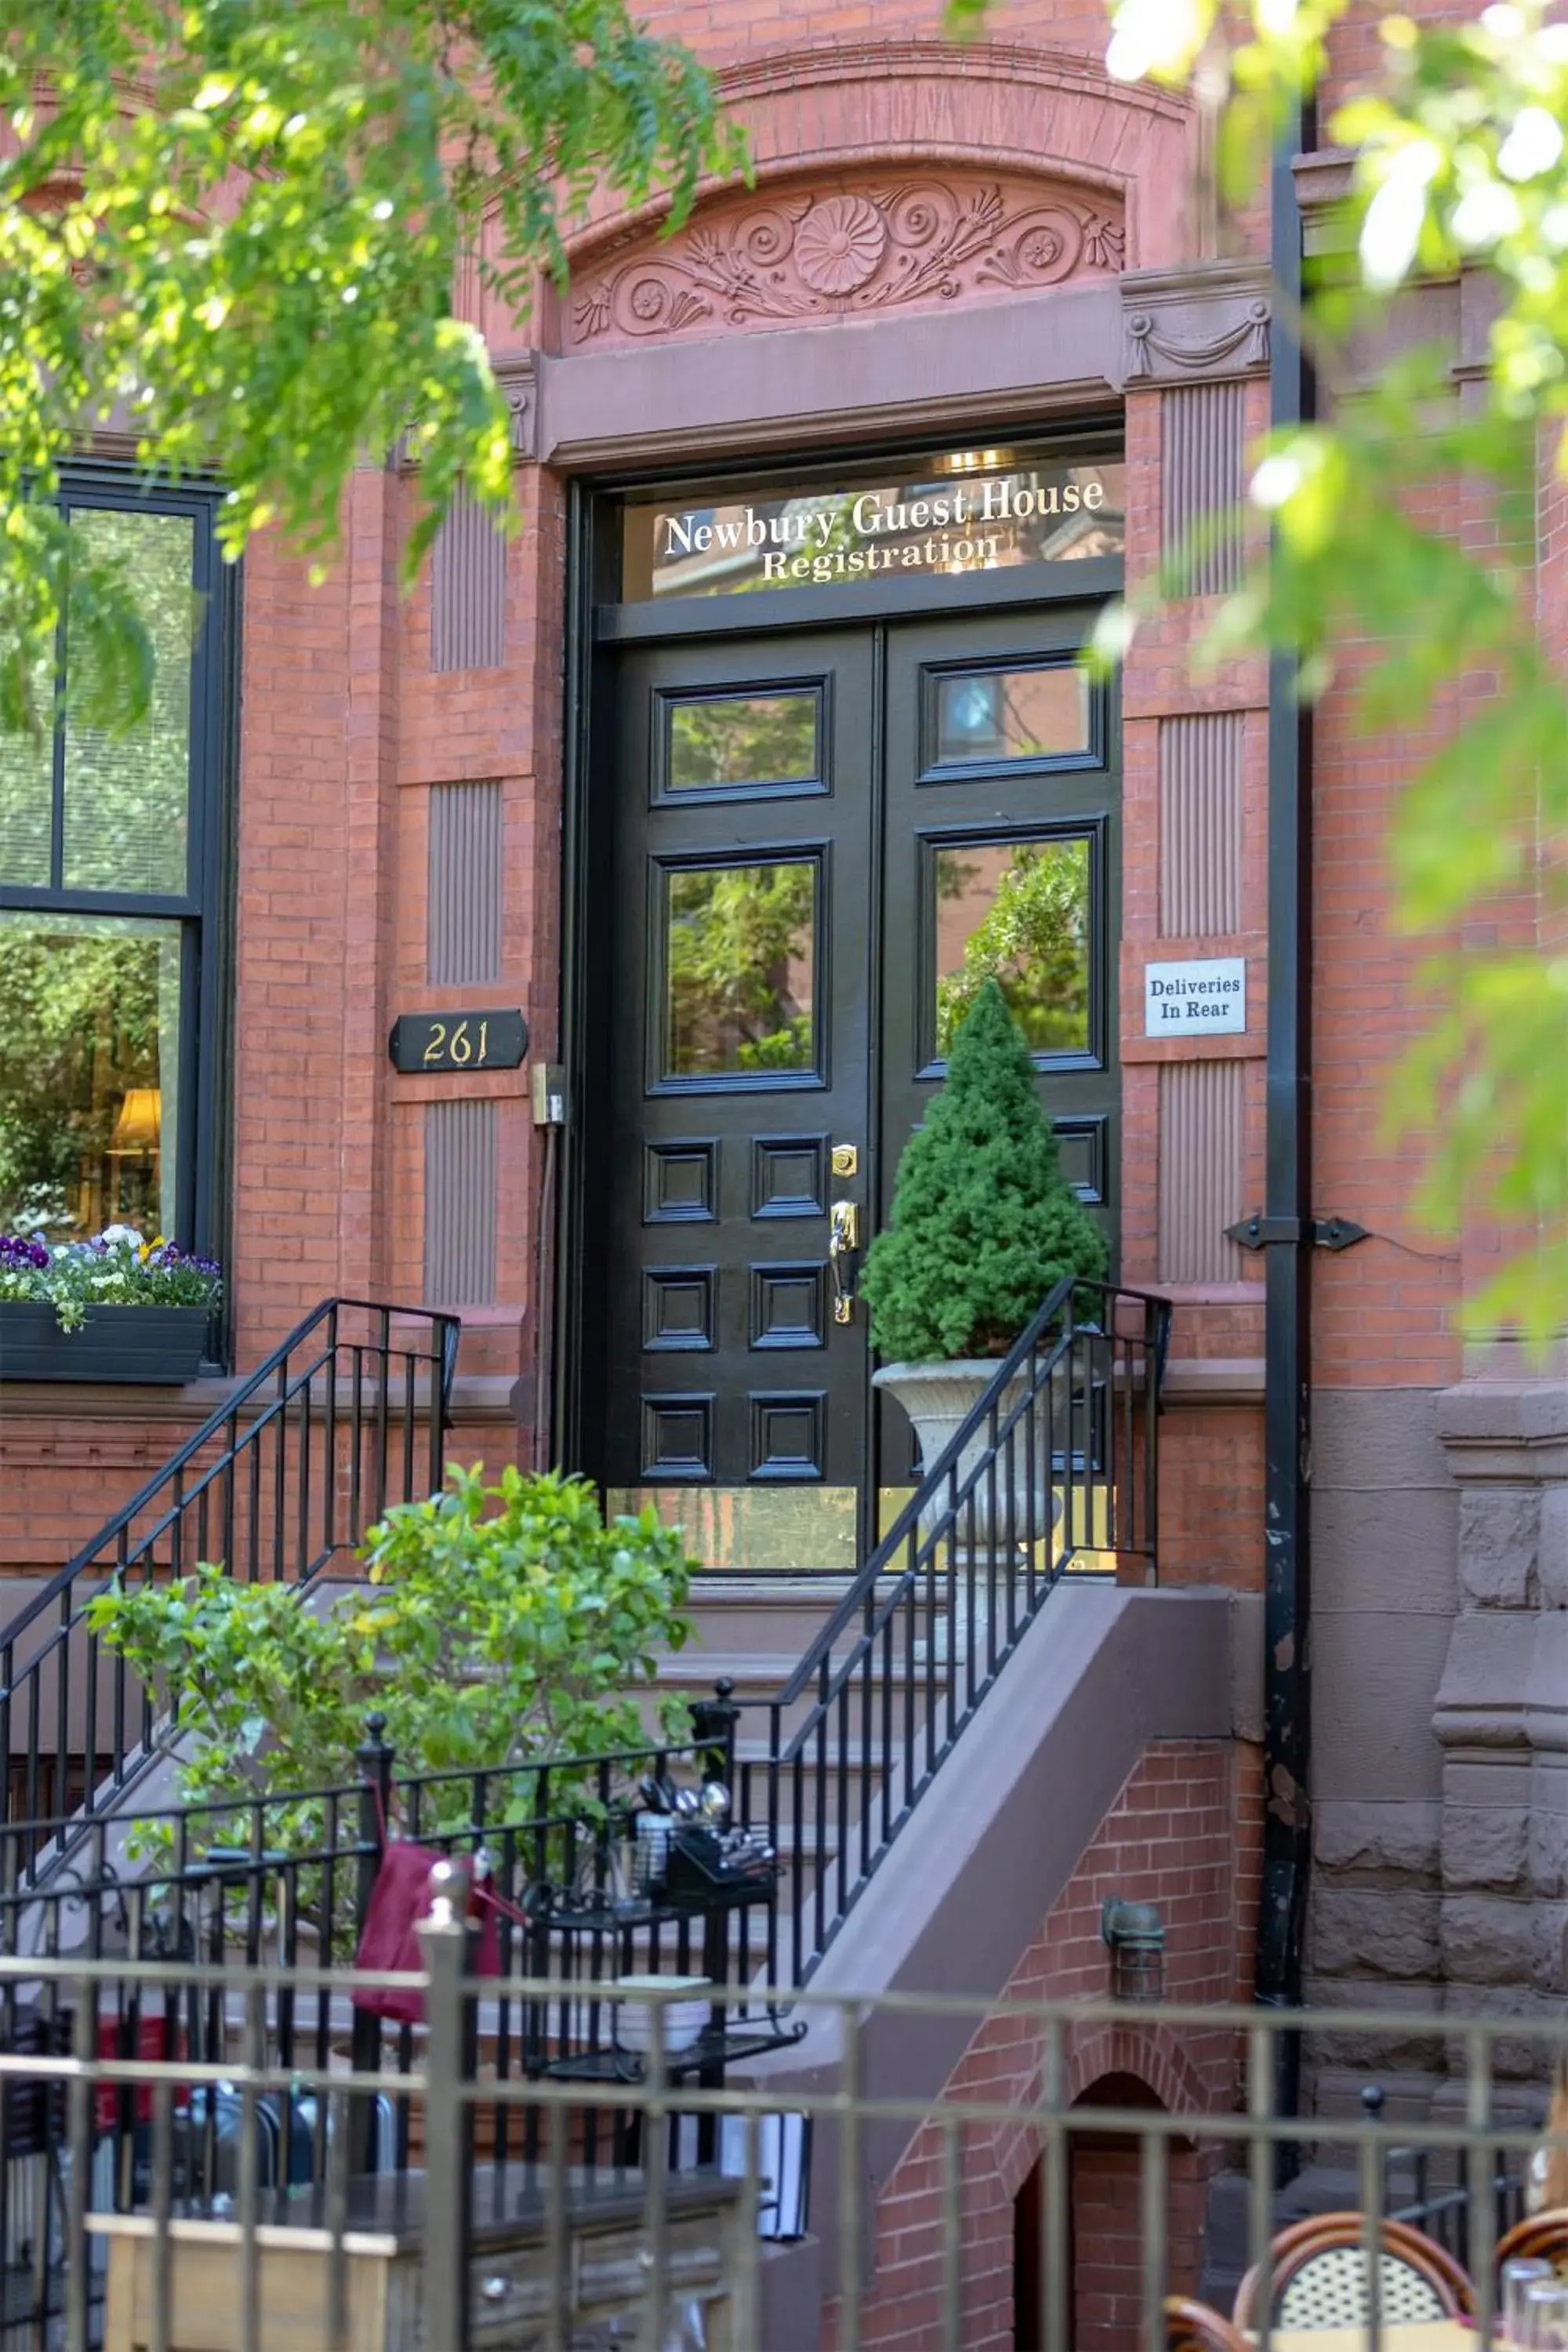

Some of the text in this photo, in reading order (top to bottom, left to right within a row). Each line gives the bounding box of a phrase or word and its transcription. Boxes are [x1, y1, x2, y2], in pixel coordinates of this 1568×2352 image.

[663, 481, 1104, 554] Newbury Guest House
[761, 534, 999, 583] Registration
[1150, 976, 1240, 996] Deliveries
[1161, 1001, 1229, 1018] In Rear
[423, 1020, 488, 1062] 261
